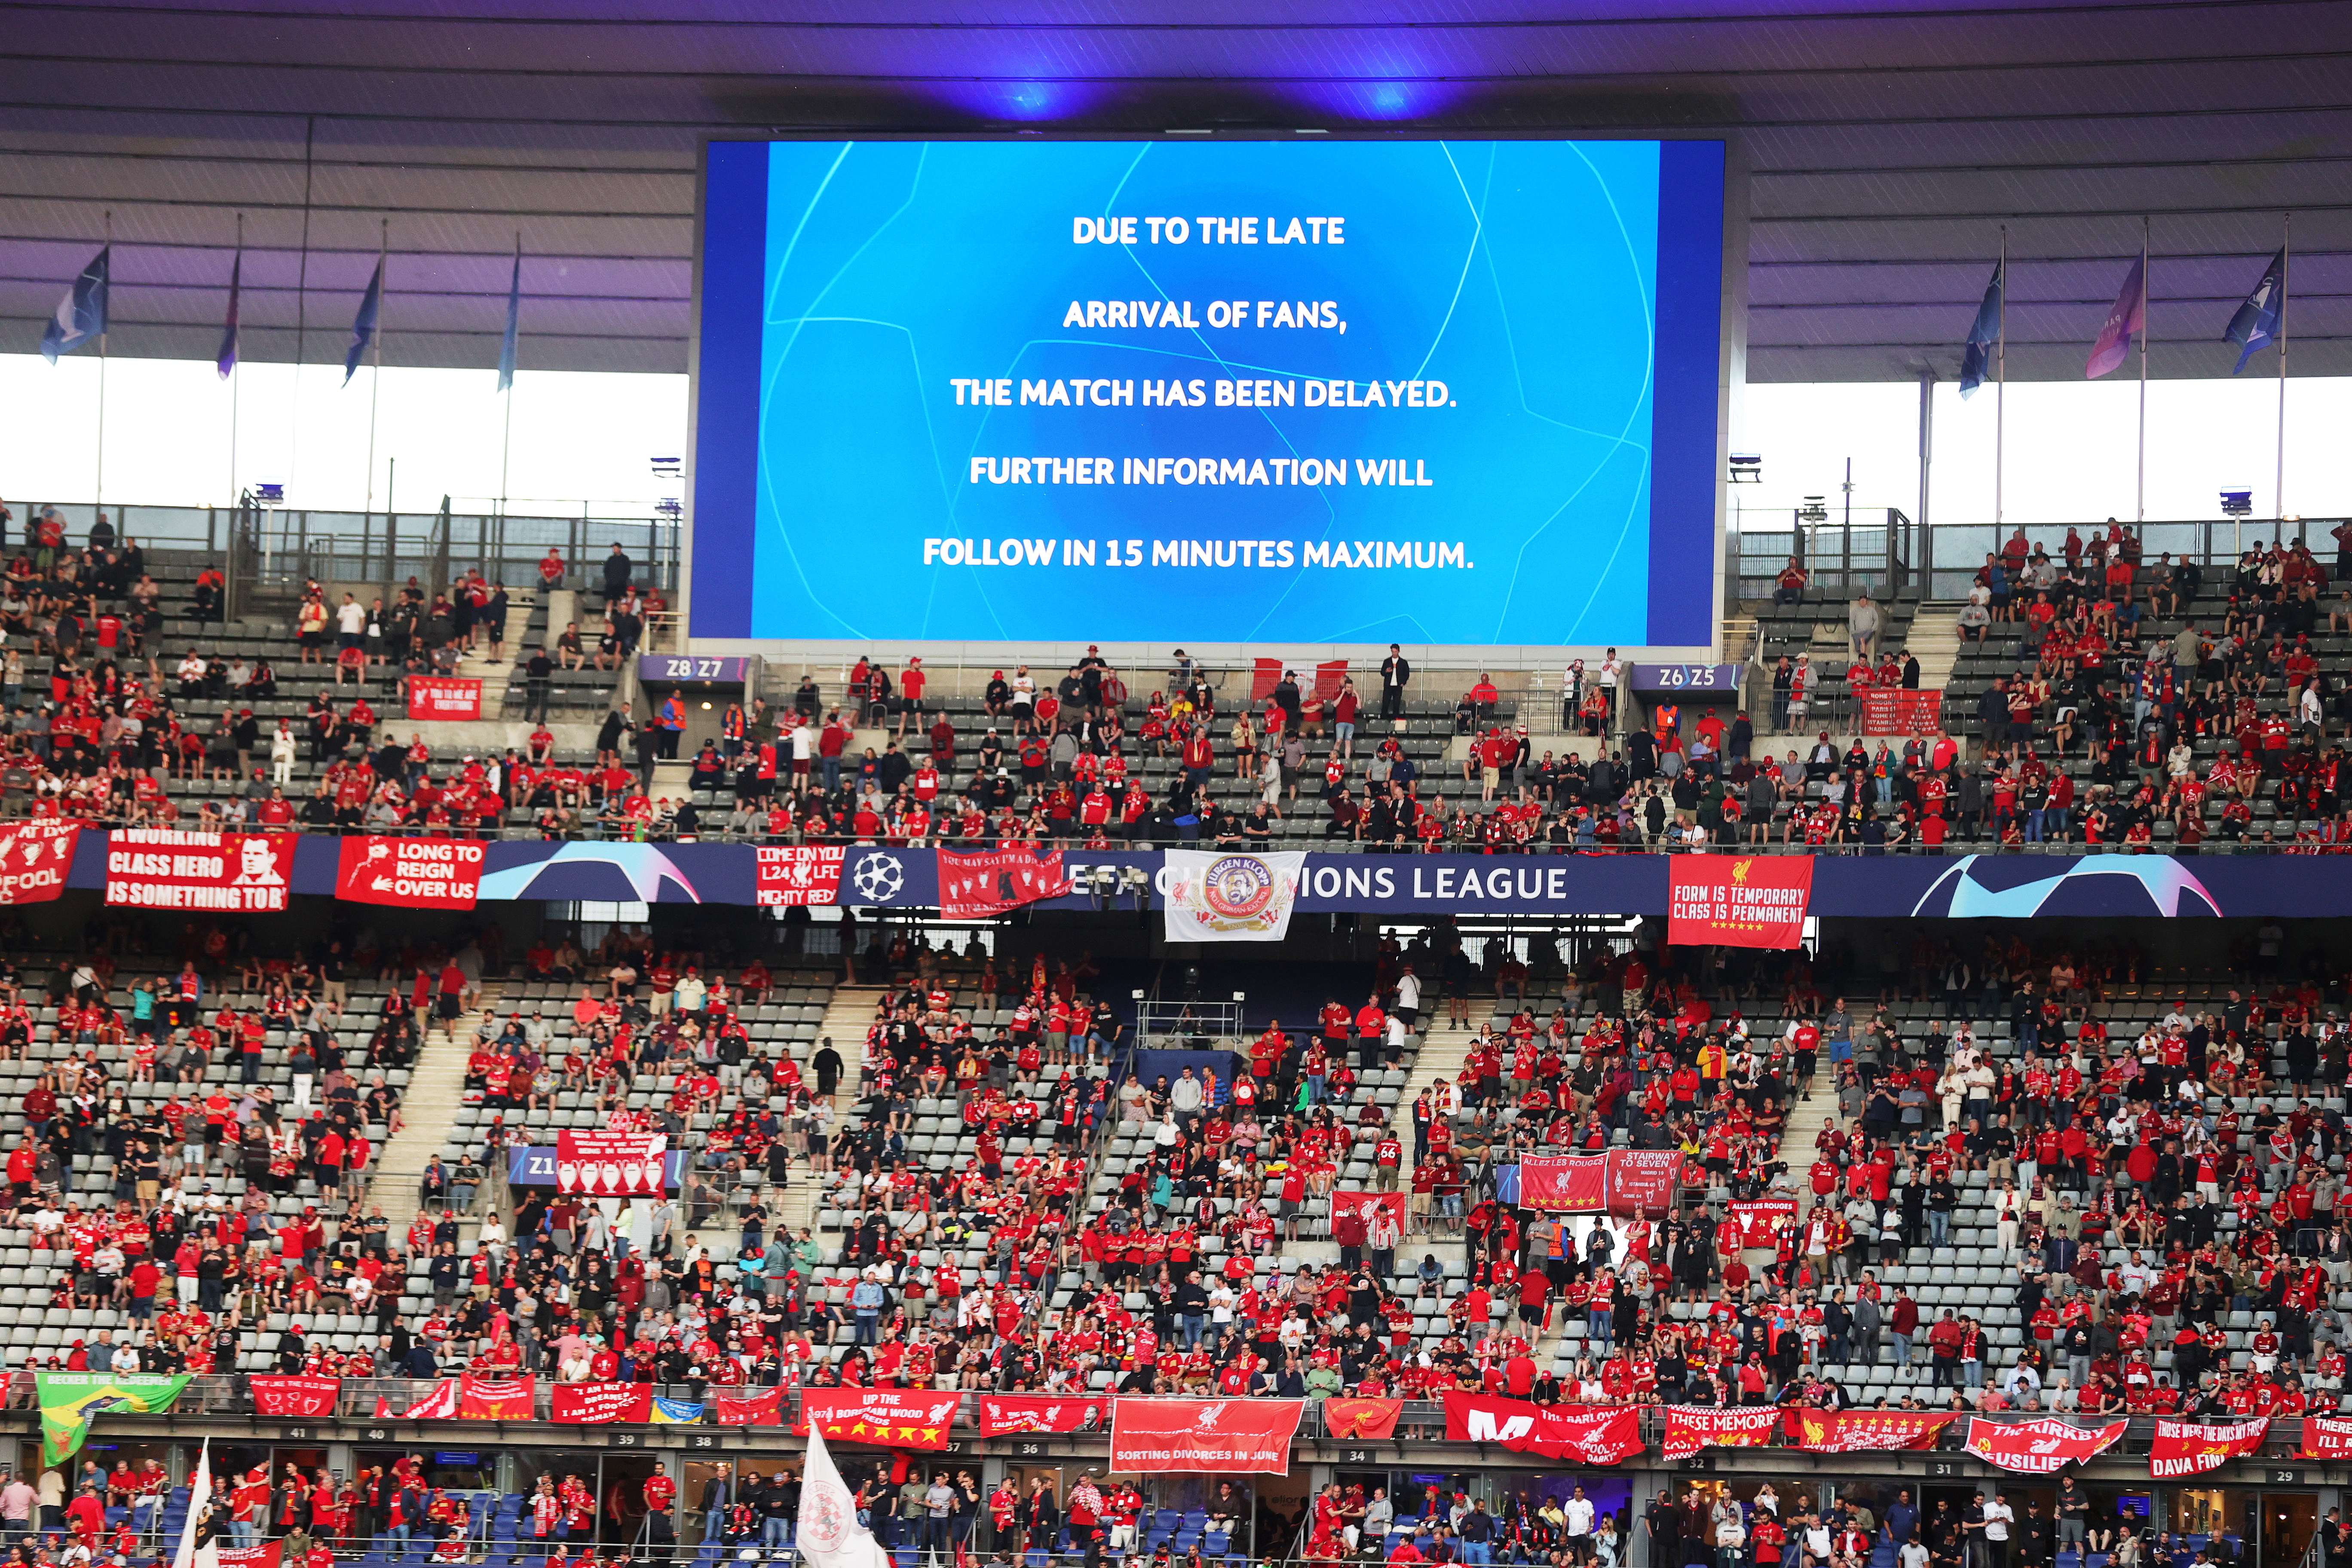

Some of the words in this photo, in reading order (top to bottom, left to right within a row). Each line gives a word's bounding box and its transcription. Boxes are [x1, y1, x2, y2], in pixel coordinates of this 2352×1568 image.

[1074, 217, 1137, 244] DUE
[1145, 217, 1189, 244] TO
[1197, 217, 1258, 243] THE
[1268, 217, 1344, 243] LATE
[1063, 301, 1199, 328] ARRIVAL
[1207, 301, 1249, 328] OF
[1257, 301, 1346, 334] FANS,
[950, 379, 1012, 405] THE
[1020, 379, 1133, 406] MATCH
[1143, 380, 1206, 406] HAS
[1215, 380, 1295, 406] BEEN
[1305, 380, 1456, 407] DELAYED.
[971, 457, 1115, 484] FURTHER
[1124, 458, 1346, 485] INFORMATION
[1356, 459, 1433, 486] WILL
[924, 538, 1056, 566] FOLLOW
[1064, 540, 1095, 566] IN
[1106, 540, 1142, 566] 15
[1152, 540, 1294, 567] MINUTES
[1304, 541, 1473, 568] MAXIMUM.
[666, 659, 692, 677] Z8
[698, 660, 723, 677] Z7
[1659, 669, 1683, 686] Z6
[1691, 669, 1715, 686] Z5
[110, 829, 125, 842] A
[127, 829, 221, 847] WORKING
[398, 842, 453, 861] LONG
[455, 845, 482, 863] TO
[757, 848, 795, 862] COME
[796, 847, 817, 861] ON
[818, 846, 846, 861] YOU
[109, 851, 171, 876] CLASS
[173, 854, 224, 879] HERO
[943, 855, 961, 866] YOU
[963, 858, 982, 867] MAY
[984, 857, 999, 866] SAY
[396, 861, 454, 879] REIGN
[762, 866, 791, 880] L24
[813, 865, 840, 879] LFC
[1207, 859, 1241, 885] JÜRGEN
[1243, 859, 1270, 885] KLOPP
[394, 879, 447, 897] OVER
[450, 882, 475, 899] US
[1414, 868, 1567, 899] LEAGUE
[107, 881, 128, 903] IS
[129, 882, 242, 909] SOMETHING
[243, 887, 268, 909] TO
[757, 889, 805, 904] MIGHTY
[1218, 902, 1246, 914] GERMAN
[1246, 890, 1267, 911] EXPORT
[1674, 885, 1709, 902] FORM
[1712, 885, 1726, 902] IS
[1730, 886, 1805, 906] TEMPORARY
[1673, 903, 1710, 919] CLASS
[1715, 903, 1727, 920] IS
[1732, 904, 1804, 923] PERMANENT
[1381, 1146, 1396, 1159] 66
[1626, 1152, 1678, 1161] STAIRWAY
[528, 1157, 555, 1175] Z1
[1523, 1157, 1550, 1167] ALLEZ
[1551, 1158, 1567, 1167] LES
[1569, 1157, 1604, 1167] ROUGES
[1620, 1159, 1633, 1167] TO
[1635, 1160, 1669, 1168] SEVEN
[47, 1375, 88, 1385] BECKER
[92, 1375, 113, 1385] THE
[114, 1375, 172, 1386] REDEEMER
[586, 1385, 601, 1394] AM
[584, 1392, 630, 1404] DREAMER
[862, 1393, 878, 1405] UP
[880, 1393, 902, 1405] THE
[861, 1413, 891, 1426] REDS
[889, 1408, 924, 1418] WOOD
[1566, 1409, 1619, 1424] BARLOW
[1036, 1421, 1053, 1432] LIKE
[1670, 1412, 1710, 1431] THESE
[289, 1427, 306, 1438] 41
[368, 1430, 385, 1439] 40
[1993, 1425, 2022, 1437] The
[2026, 1421, 2106, 1441] KIRKBY
[2158, 1420, 2181, 1438] THOSE
[2181, 1423, 2203, 1439] WERE
[2202, 1425, 2216, 1442] THE
[2217, 1425, 2235, 1442] DAYS
[2235, 1424, 2246, 1440] MY
[618, 1435, 635, 1445] 39
[695, 1436, 712, 1447] 38
[946, 1442, 961, 1452] 37
[2318, 1435, 2340, 1449] I'LL
[1022, 1443, 1038, 1454] 36
[1116, 1450, 1171, 1461] SORTING
[1173, 1449, 1232, 1461] DIVORCES
[1234, 1450, 1247, 1461] IN
[1250, 1450, 1279, 1461] JUNE
[1349, 1451, 1366, 1461] 34
[1689, 1458, 1704, 1469] 32
[1937, 1463, 1951, 1475] 31
[2153, 1459, 2194, 1476] DAVA
[2277, 1471, 2294, 1482] 29
